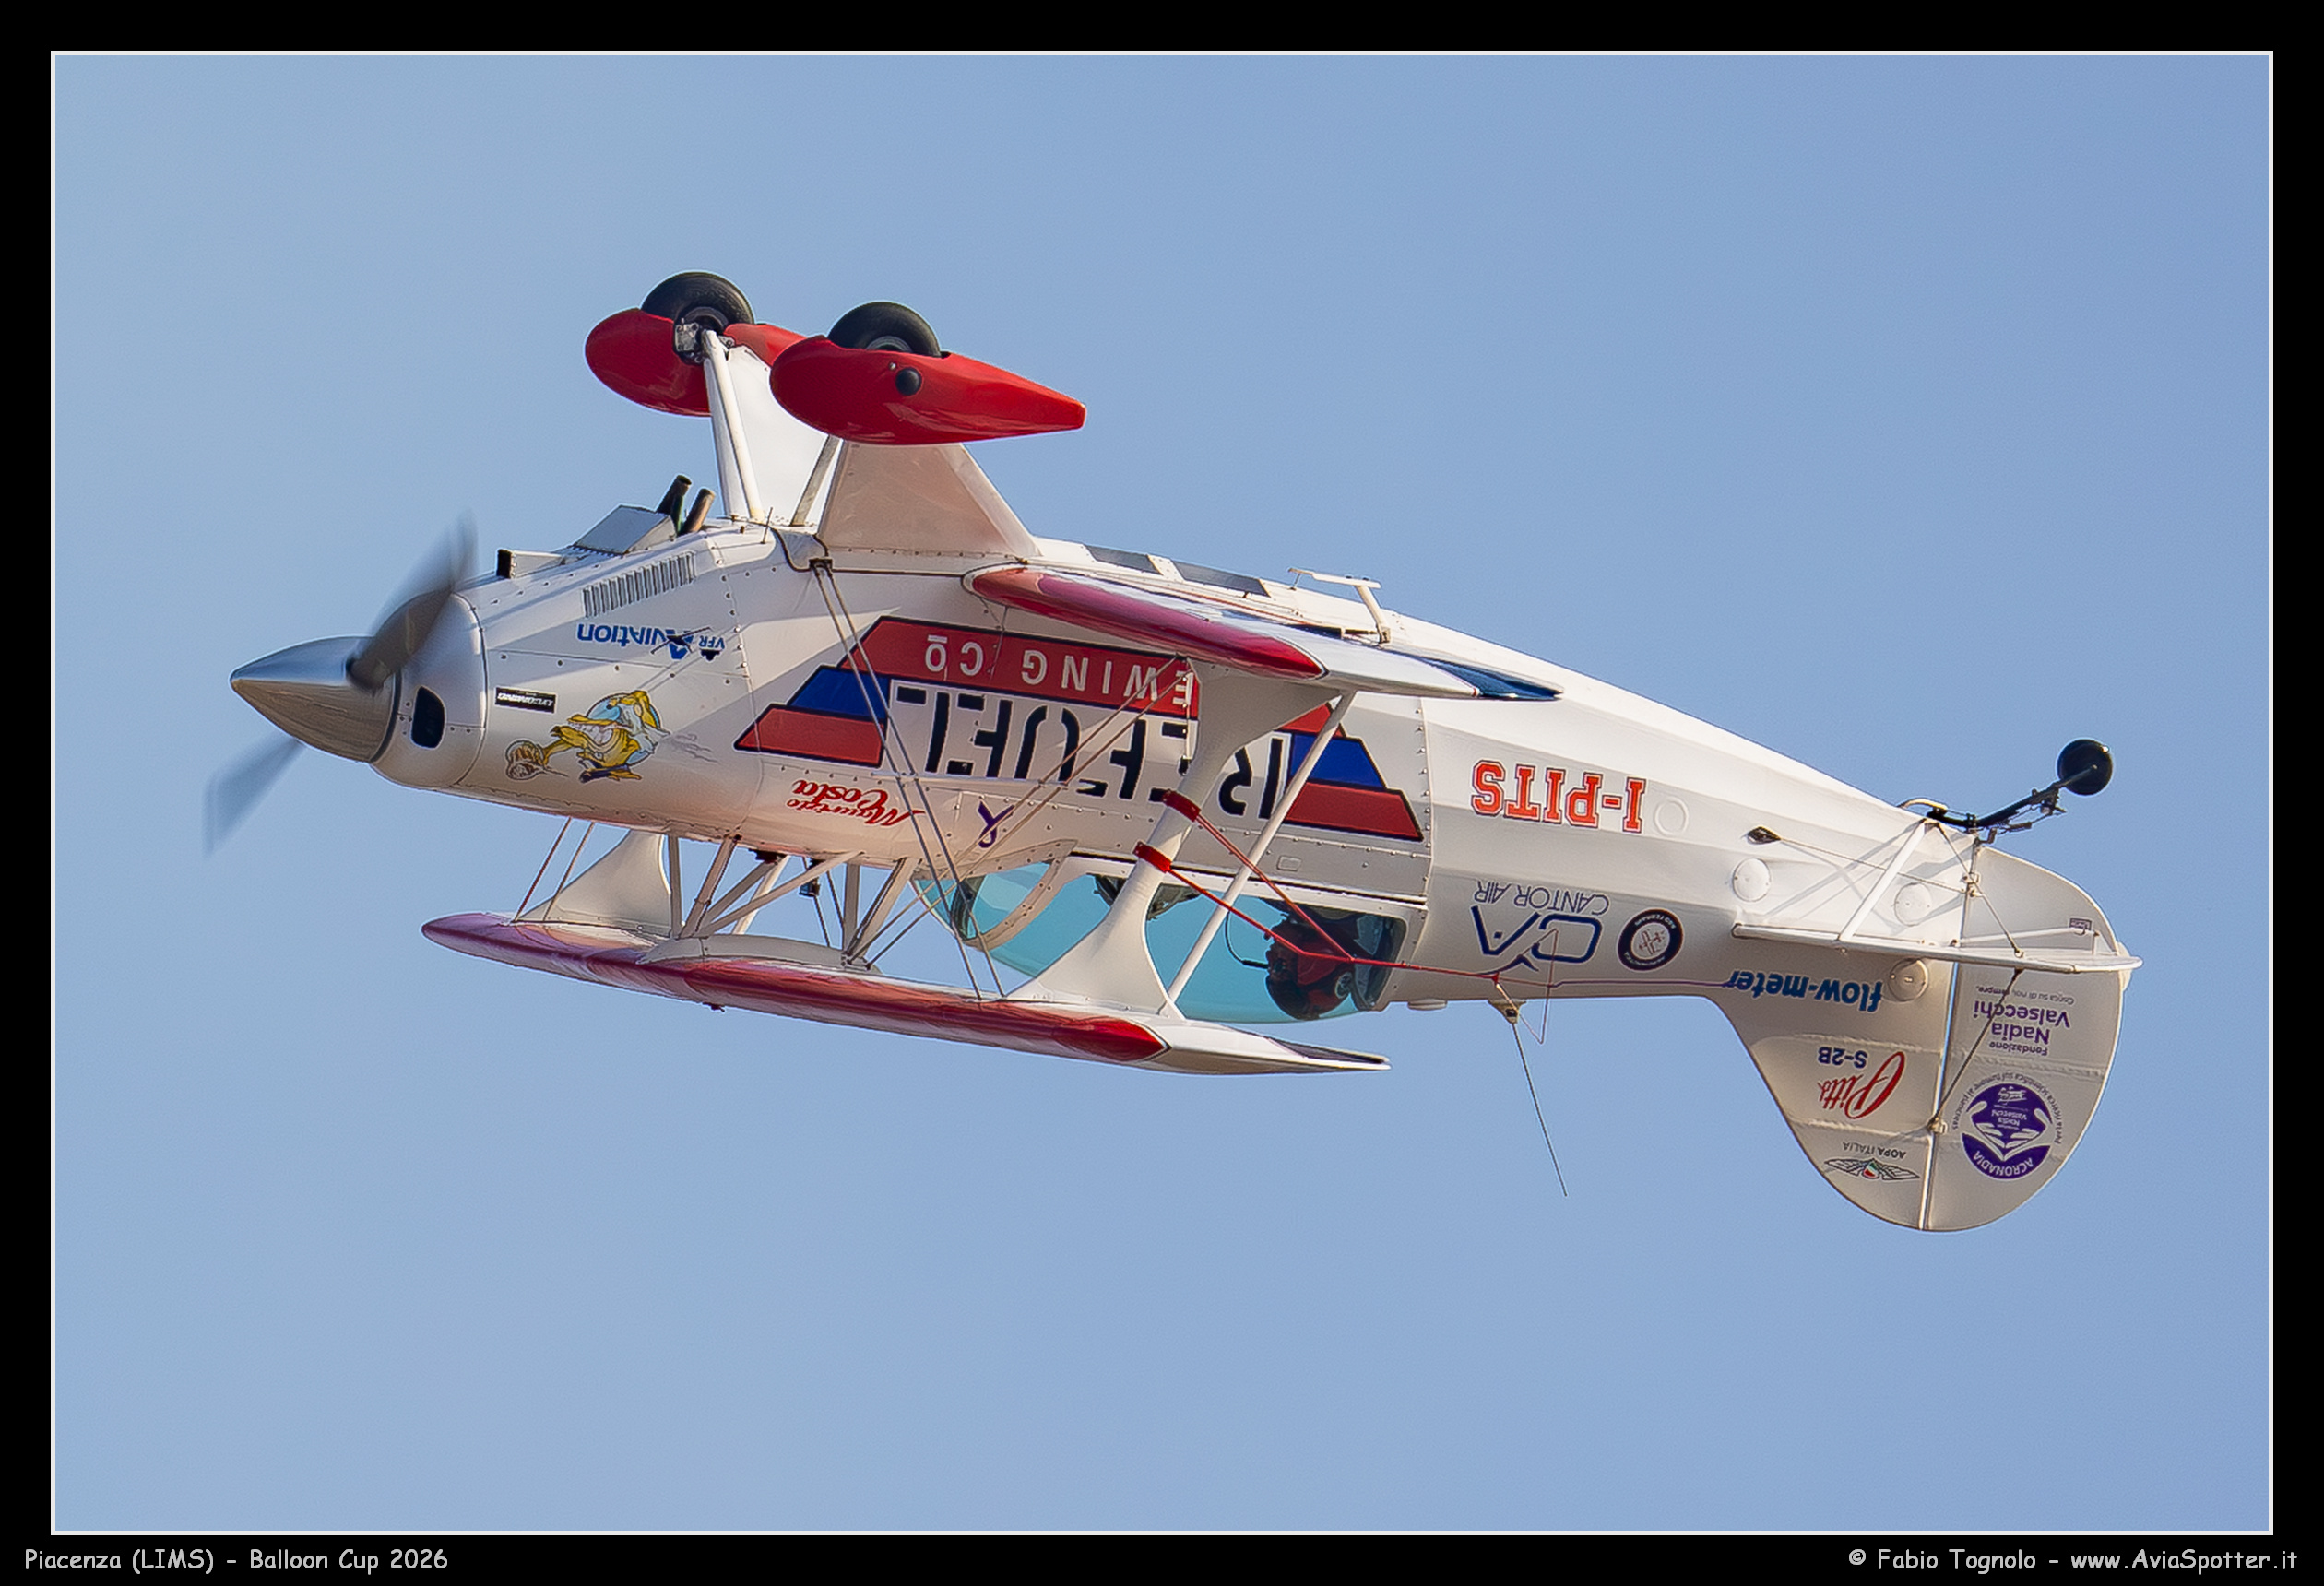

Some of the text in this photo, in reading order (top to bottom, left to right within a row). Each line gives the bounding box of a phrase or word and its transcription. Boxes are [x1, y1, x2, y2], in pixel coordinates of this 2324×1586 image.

[699, 635, 725, 649] VFR
[1021, 649, 1193, 704] EWING
[791, 780, 888, 811] Costa
[1471, 760, 1646, 834] I-PITS
[1474, 881, 1609, 915] CANTOR AIR
[1722, 970, 1883, 1013] flow-meter
[1973, 1000, 2070, 1028] Valsecchi
[1991, 1022, 2050, 1045] Nadia
[1817, 1046, 1868, 1070] S-2B
[1989, 1041, 2048, 1057] Fondazione
[1817, 1051, 1906, 1119] Pitts
[1842, 1142, 1906, 1160] AOPA ITALIA
[1973, 1150, 2034, 1177] ACRONADIA
